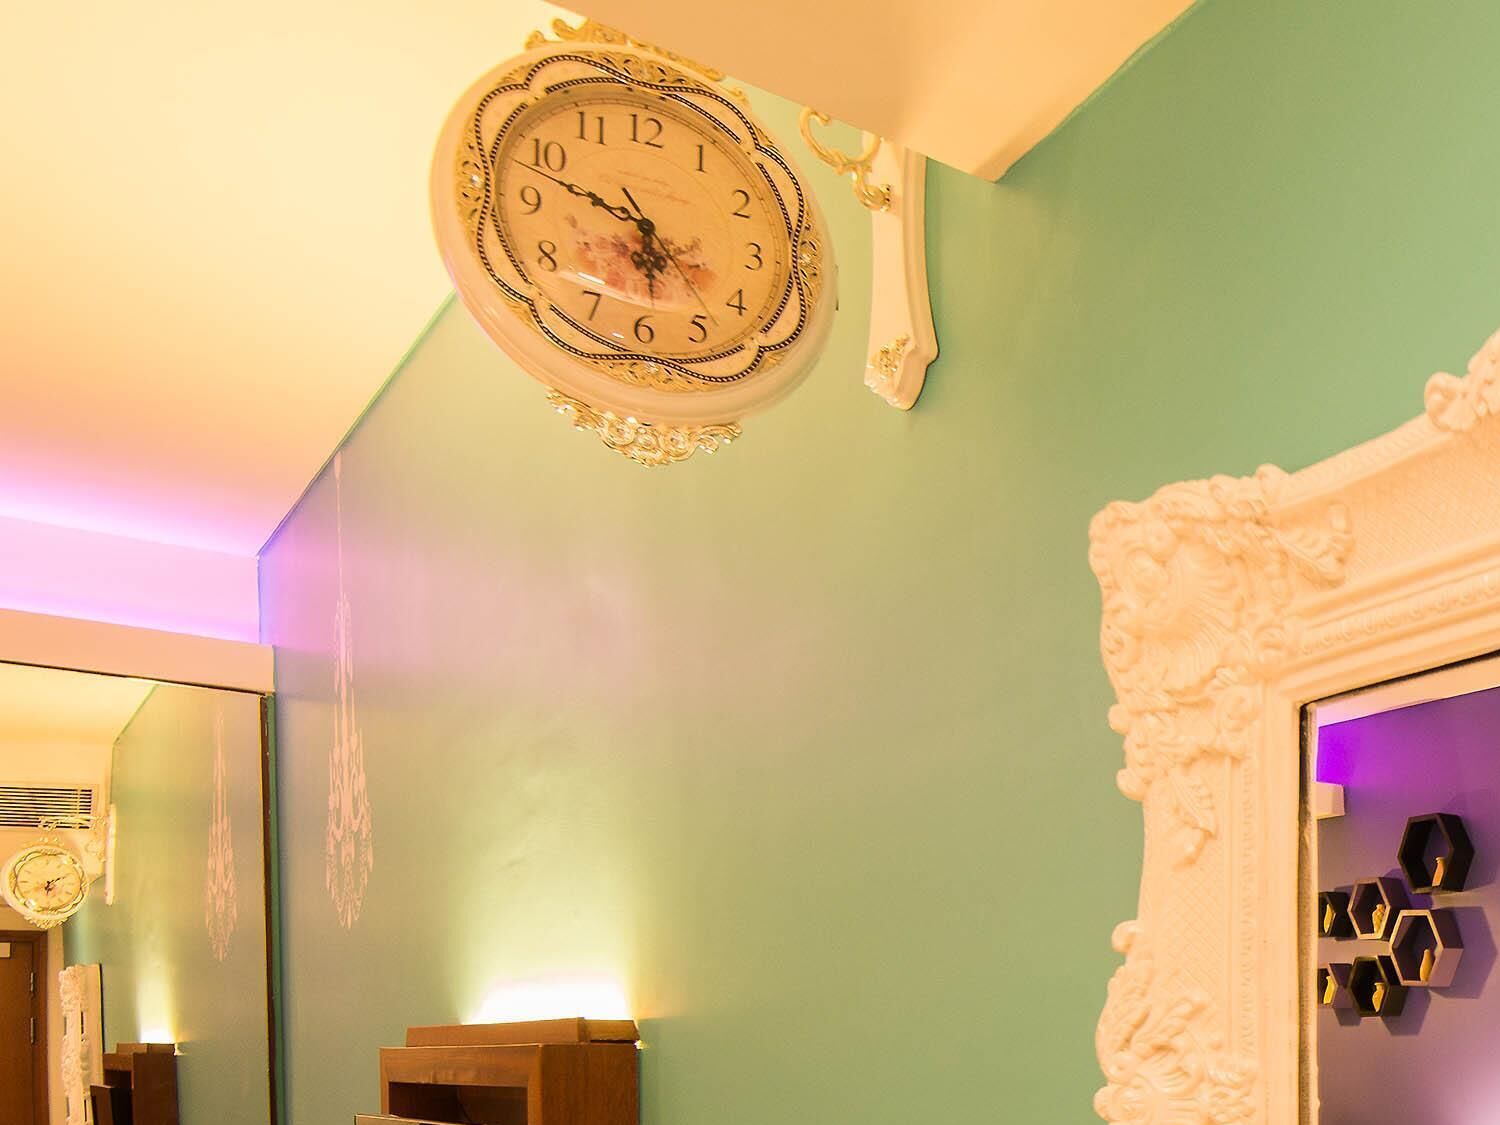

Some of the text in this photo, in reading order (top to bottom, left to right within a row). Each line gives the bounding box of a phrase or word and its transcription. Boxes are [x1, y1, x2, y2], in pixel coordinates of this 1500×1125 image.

[575, 110, 607, 146] 11
[628, 113, 665, 149] 12
[532, 138, 567, 173] 10
[694, 144, 706, 173] 1
[519, 186, 543, 216] 9
[732, 189, 751, 219] 2
[537, 240, 558, 272] 8
[744, 242, 763, 271] 3
[582, 290, 601, 322] 7
[726, 288, 747, 317] 4
[633, 315, 655, 345] 6
[688, 314, 707, 344] 5
